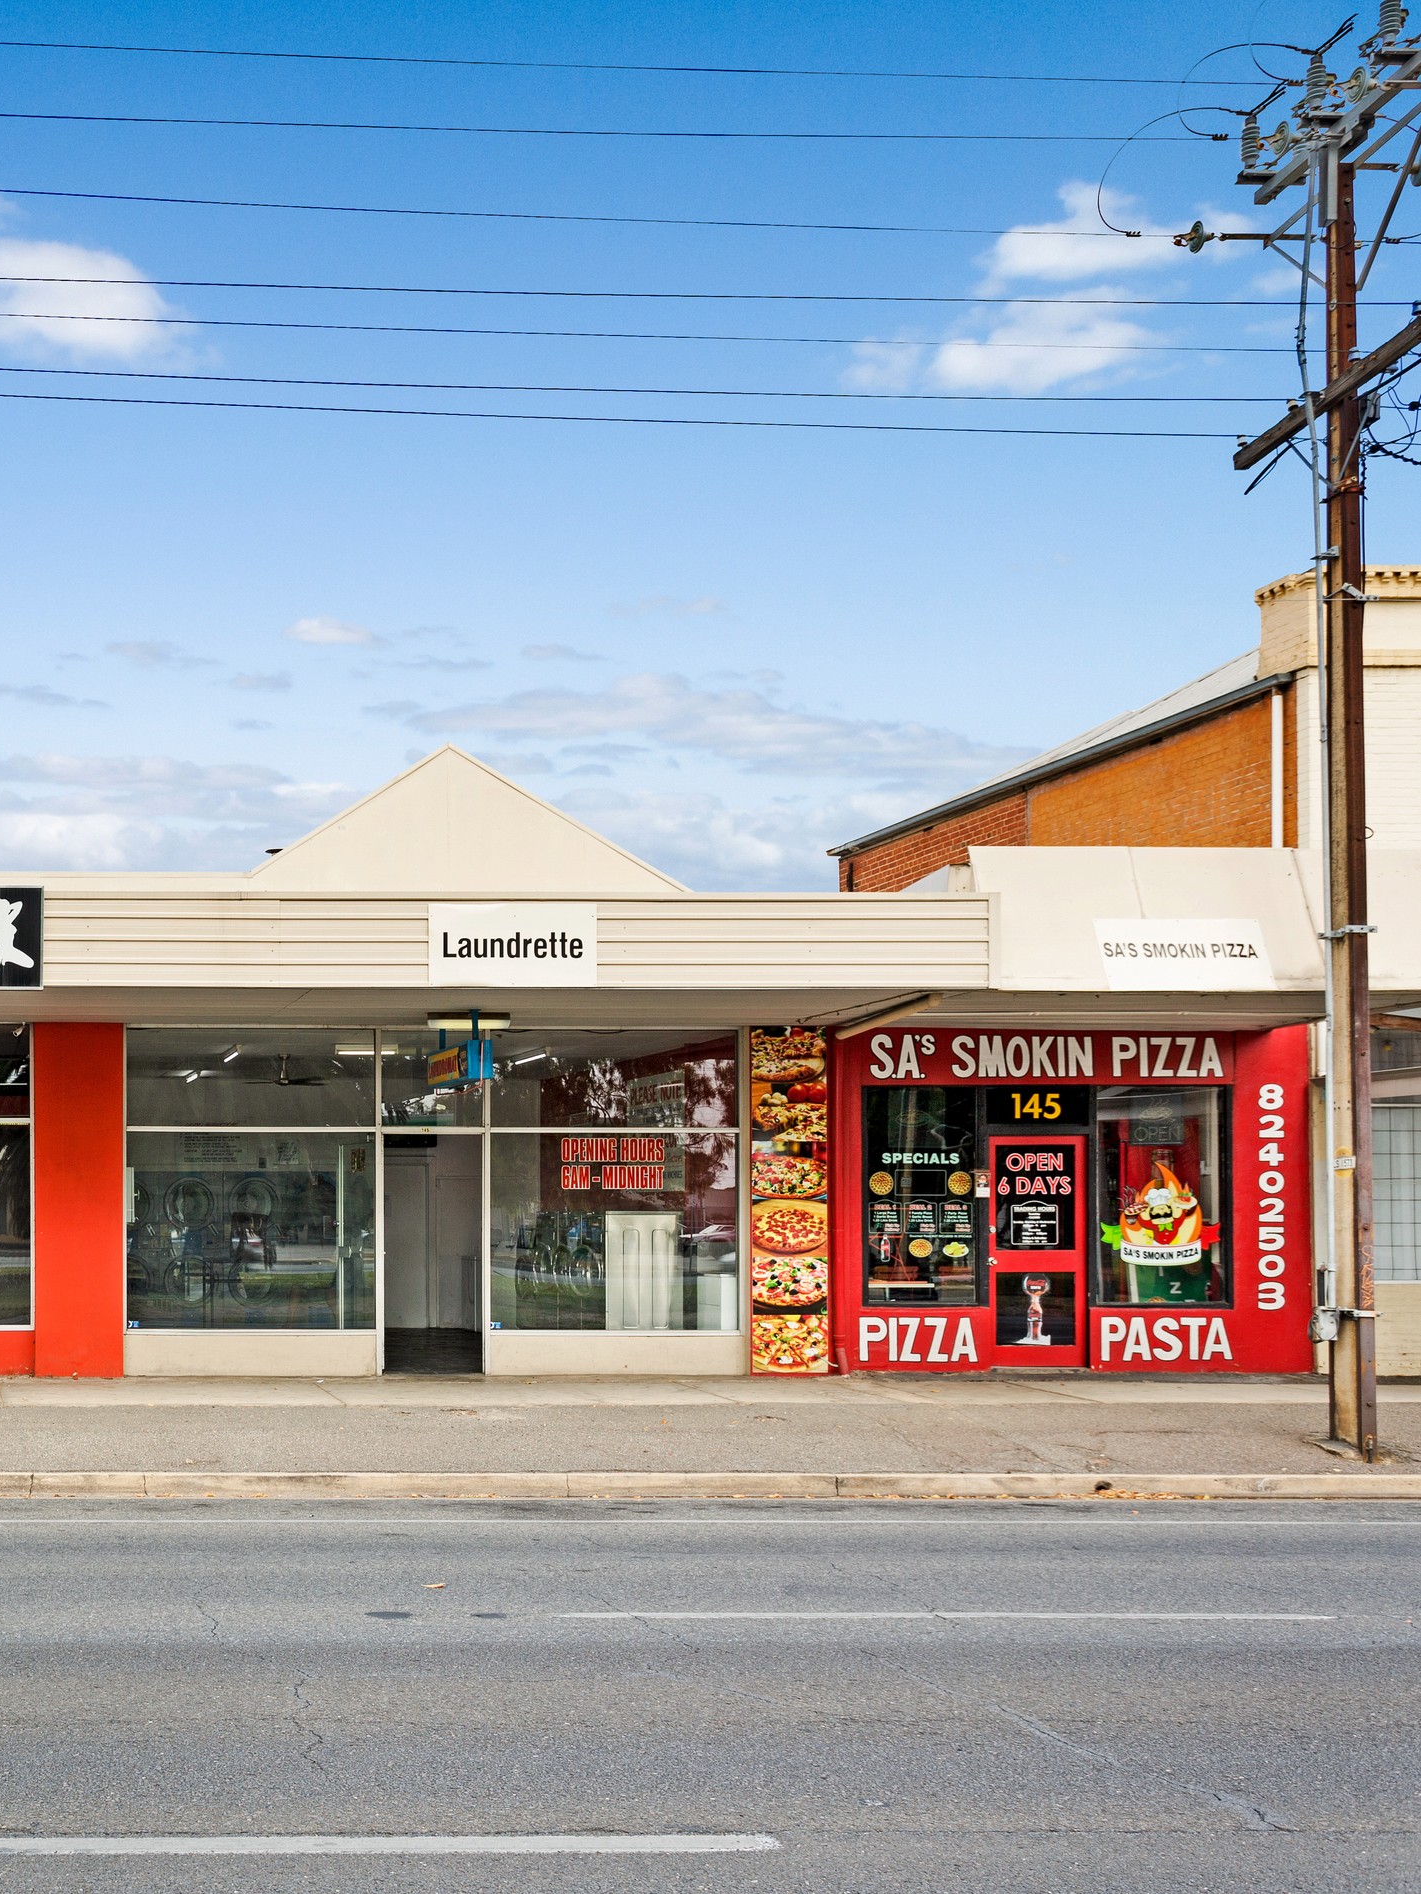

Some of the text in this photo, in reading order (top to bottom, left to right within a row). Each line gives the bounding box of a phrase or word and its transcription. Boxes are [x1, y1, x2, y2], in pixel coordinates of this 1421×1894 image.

[442, 932, 584, 959] Laundrette
[1103, 942, 1259, 959] SA'S SMOKIN PIZZA
[951, 1034, 1095, 1080] SMOKIN
[1111, 1036, 1225, 1079] PIZZA
[630, 1079, 682, 1105] PLEASE NOTE
[1011, 1093, 1062, 1120] 145
[1134, 1126, 1181, 1142] OPEN
[561, 1137, 617, 1163] OPENING
[620, 1137, 665, 1163] HOURS
[881, 1152, 960, 1165] SPECIALS
[1005, 1152, 1064, 1172] OPEN
[561, 1165, 591, 1190] 6AM
[602, 1165, 665, 1190] MIDNIGHT
[997, 1176, 1010, 1195] 6
[1015, 1176, 1072, 1195] DAYS
[1257, 1083, 1286, 1311] 82402503
[1123, 1247, 1199, 1260] SA'S SMOKIN PIZZA
[858, 1316, 979, 1363] PIZZA
[1100, 1316, 1233, 1362] PASTA
